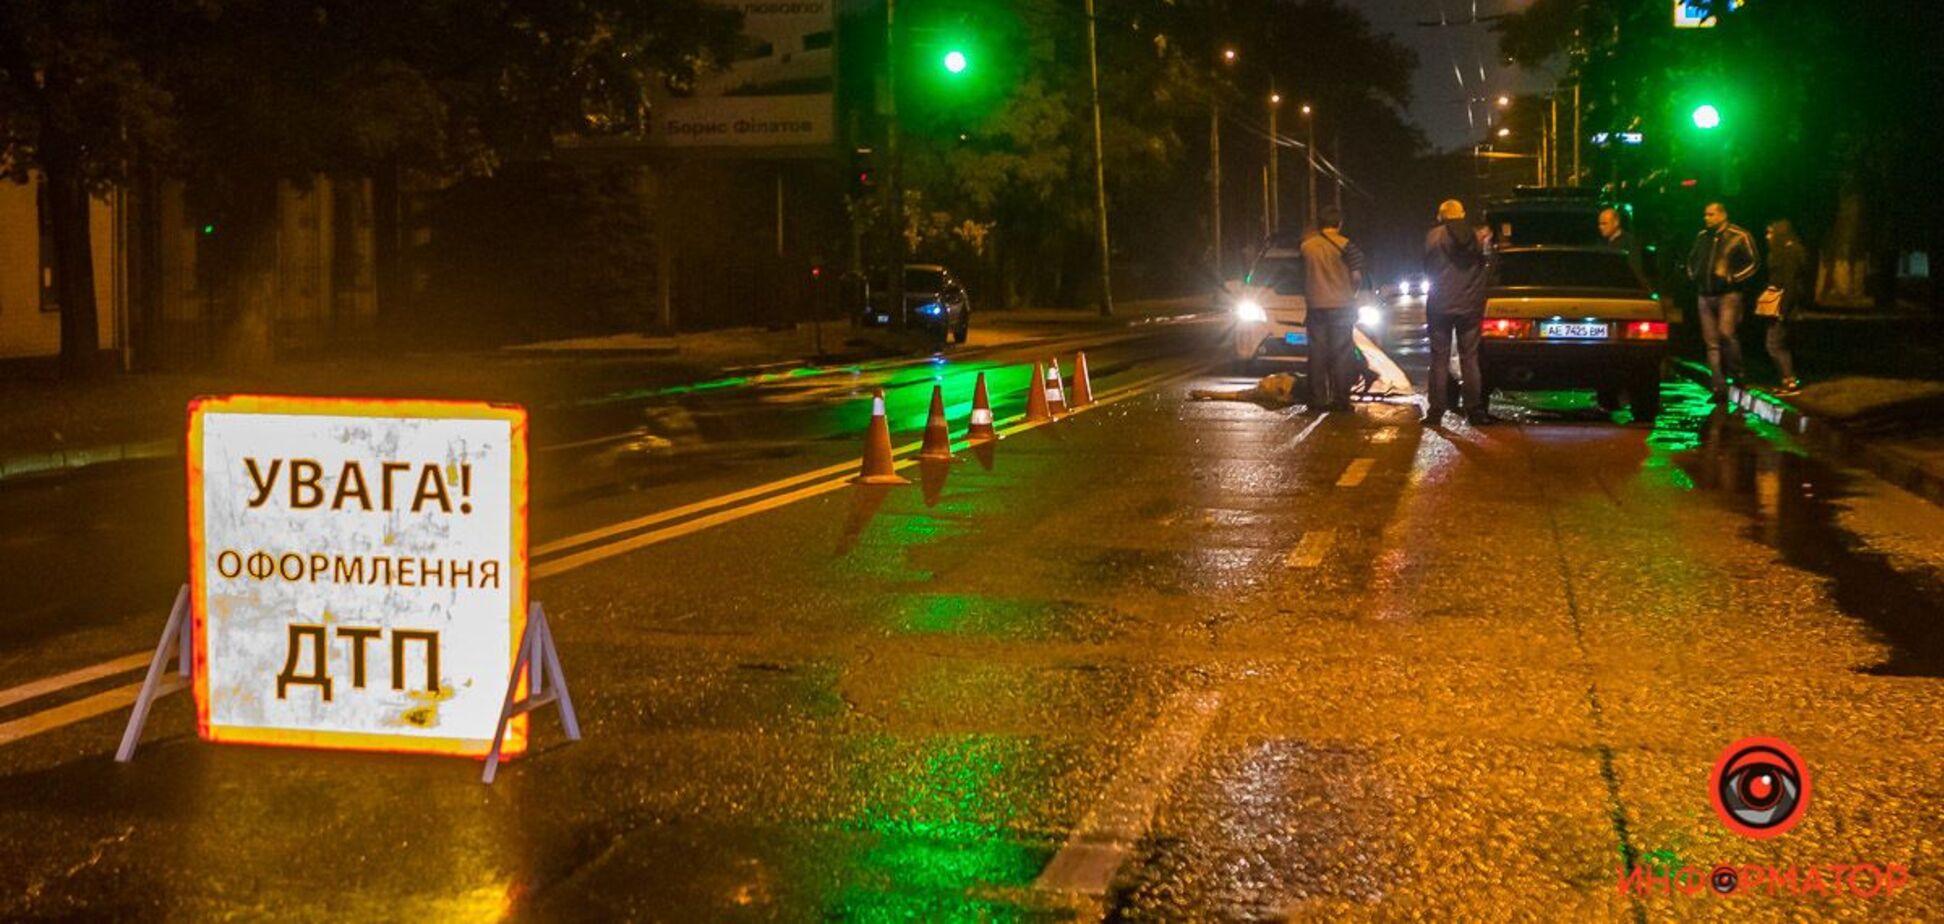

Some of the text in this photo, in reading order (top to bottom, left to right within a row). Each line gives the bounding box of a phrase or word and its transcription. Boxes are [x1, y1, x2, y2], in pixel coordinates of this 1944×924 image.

[669, 118, 812, 138] Борис Філатов
[1565, 325, 1587, 336] 7425
[243, 456, 473, 515] УВАГА!
[217, 549, 500, 590] ОФОРМЛЕННЯ
[276, 623, 441, 703] ДТП
